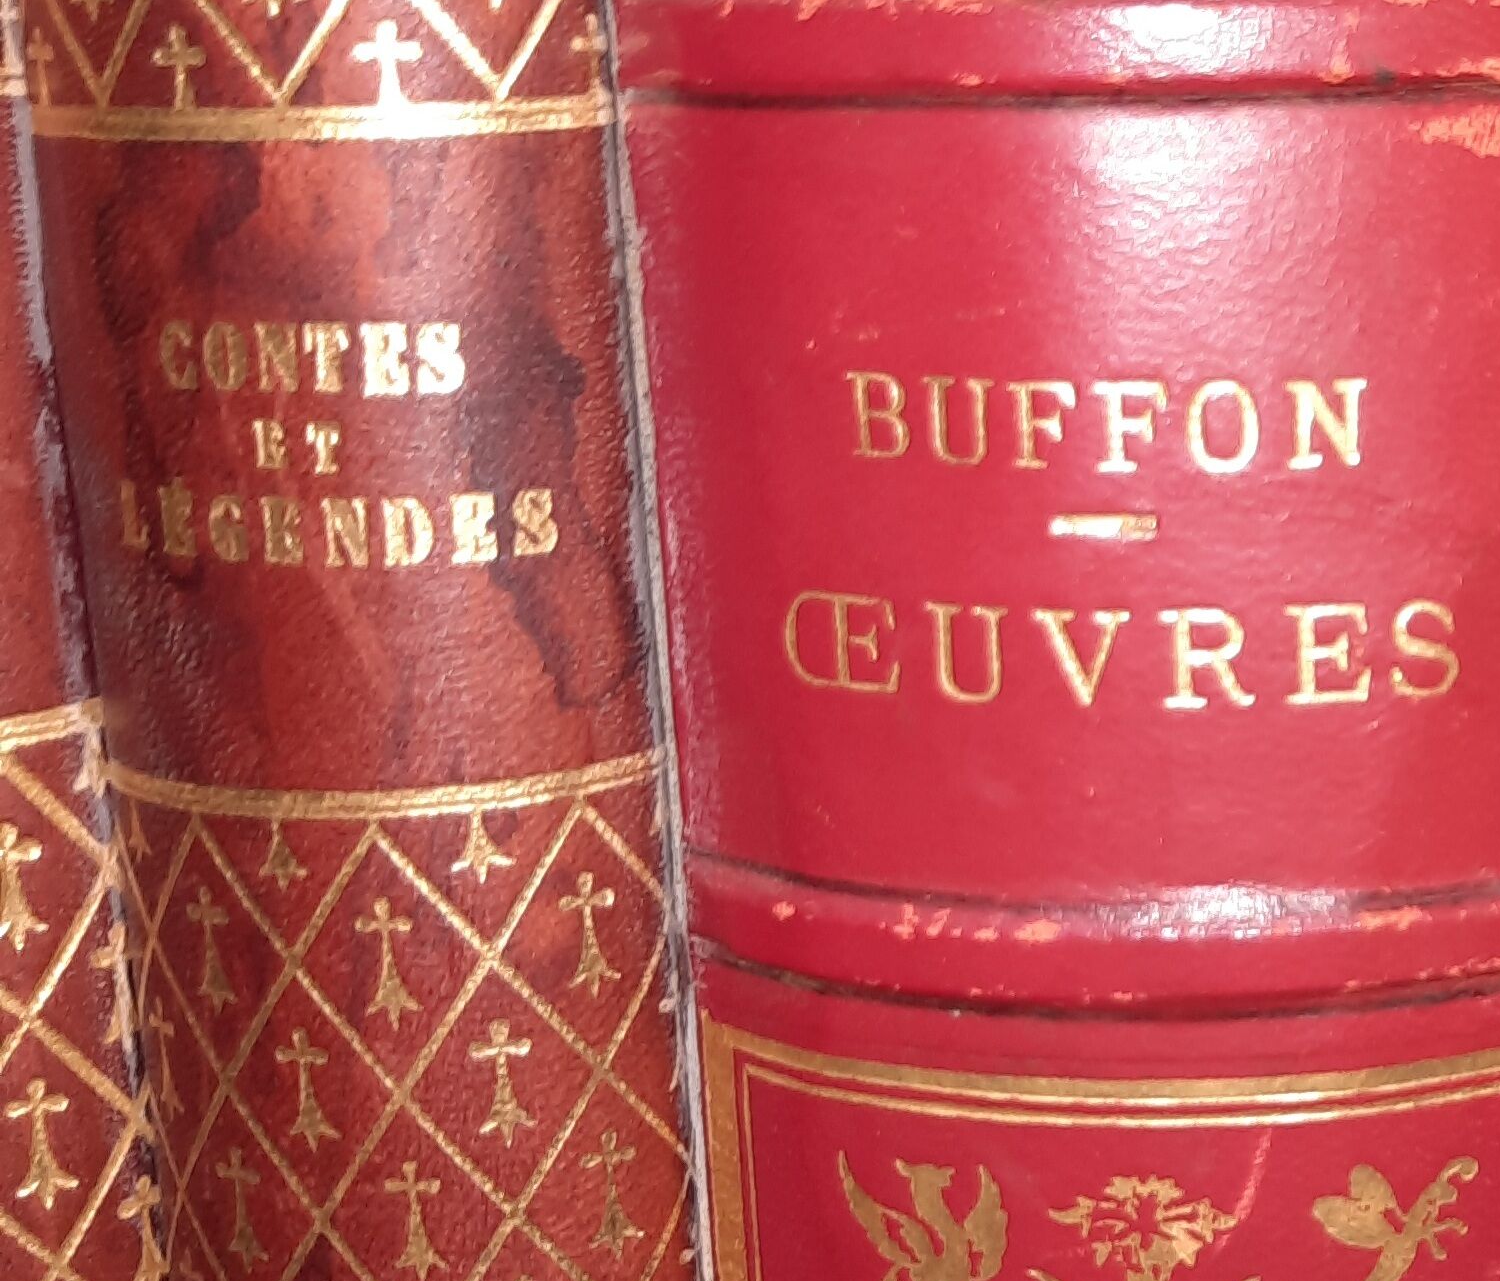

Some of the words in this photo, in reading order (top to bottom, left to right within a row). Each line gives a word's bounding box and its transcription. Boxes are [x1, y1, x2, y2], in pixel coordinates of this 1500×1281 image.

[158, 319, 467, 399] CONTES
[252, 418, 342, 476] ET
[845, 370, 1369, 475] BUFFON
[783, 588, 1461, 711] ŒUVRES
